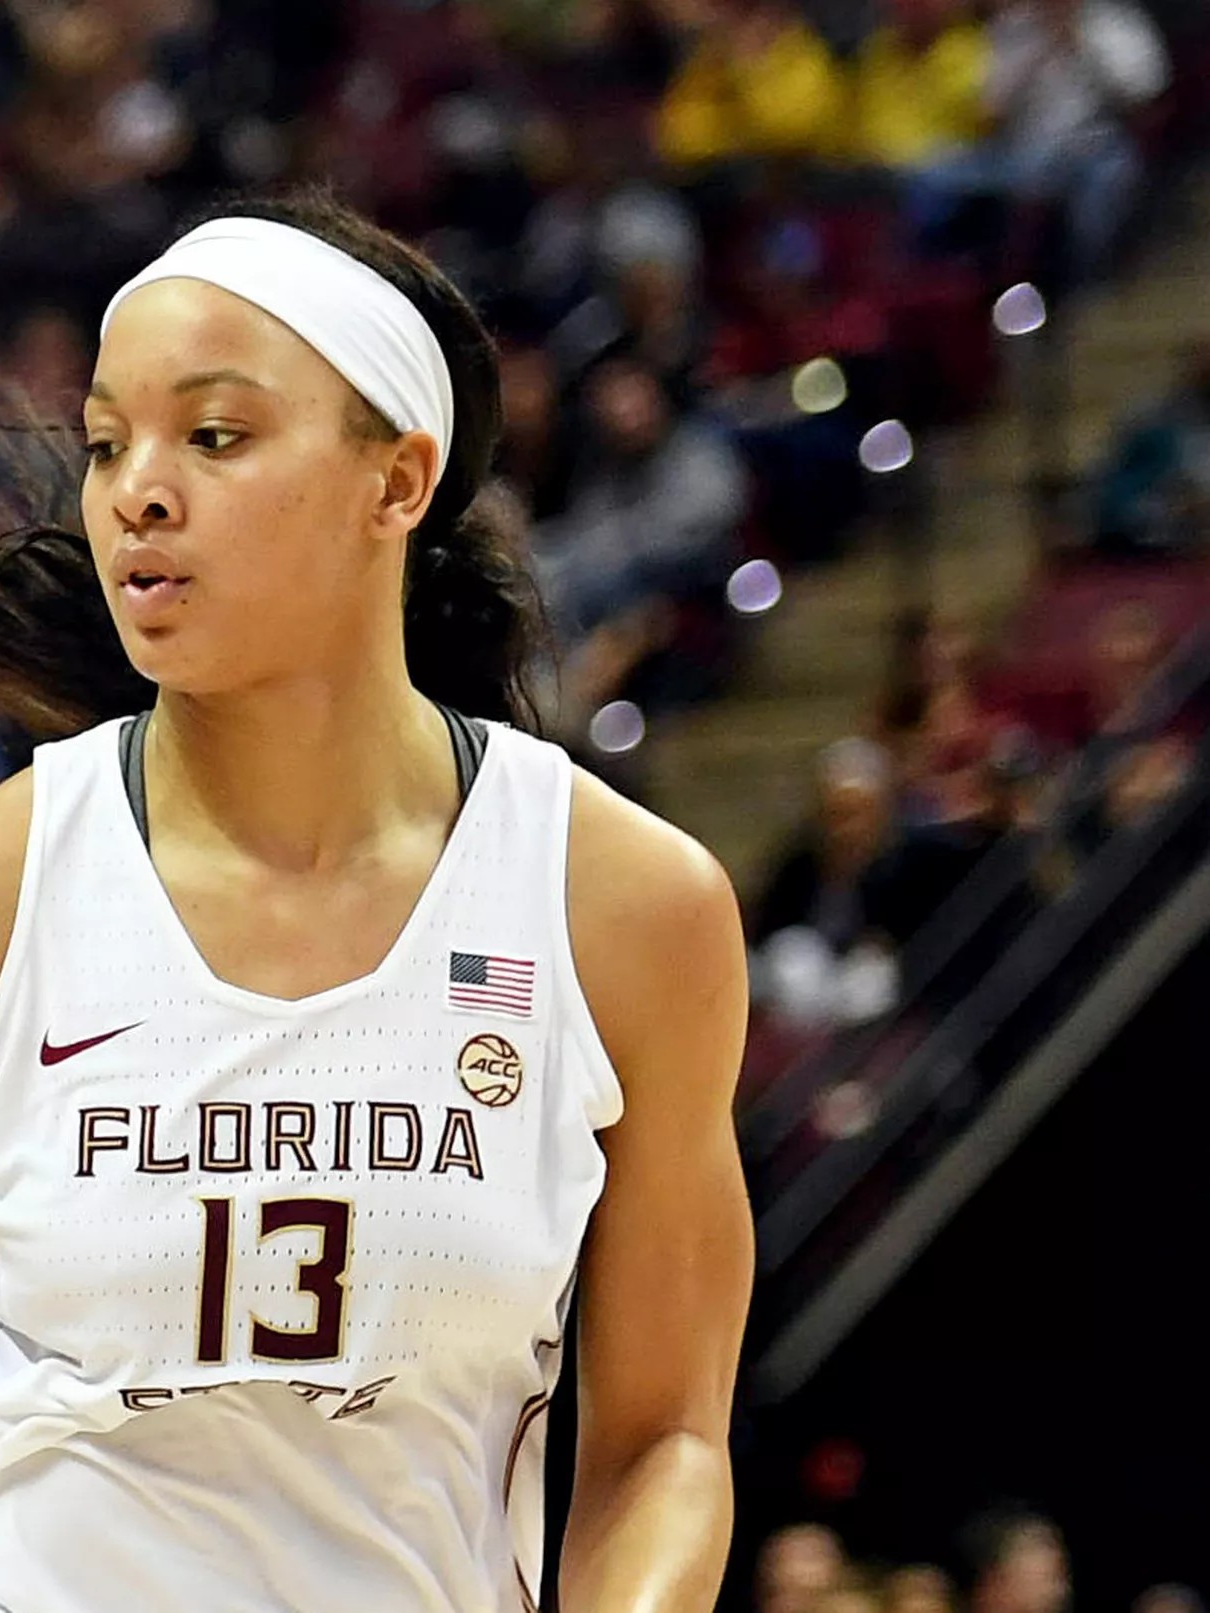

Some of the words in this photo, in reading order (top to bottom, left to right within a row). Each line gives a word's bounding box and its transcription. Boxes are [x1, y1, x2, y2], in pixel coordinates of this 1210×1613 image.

[467, 1058, 520, 1078] ACC
[74, 1100, 484, 1180] FLORIDA
[192, 1196, 356, 1366] 13
